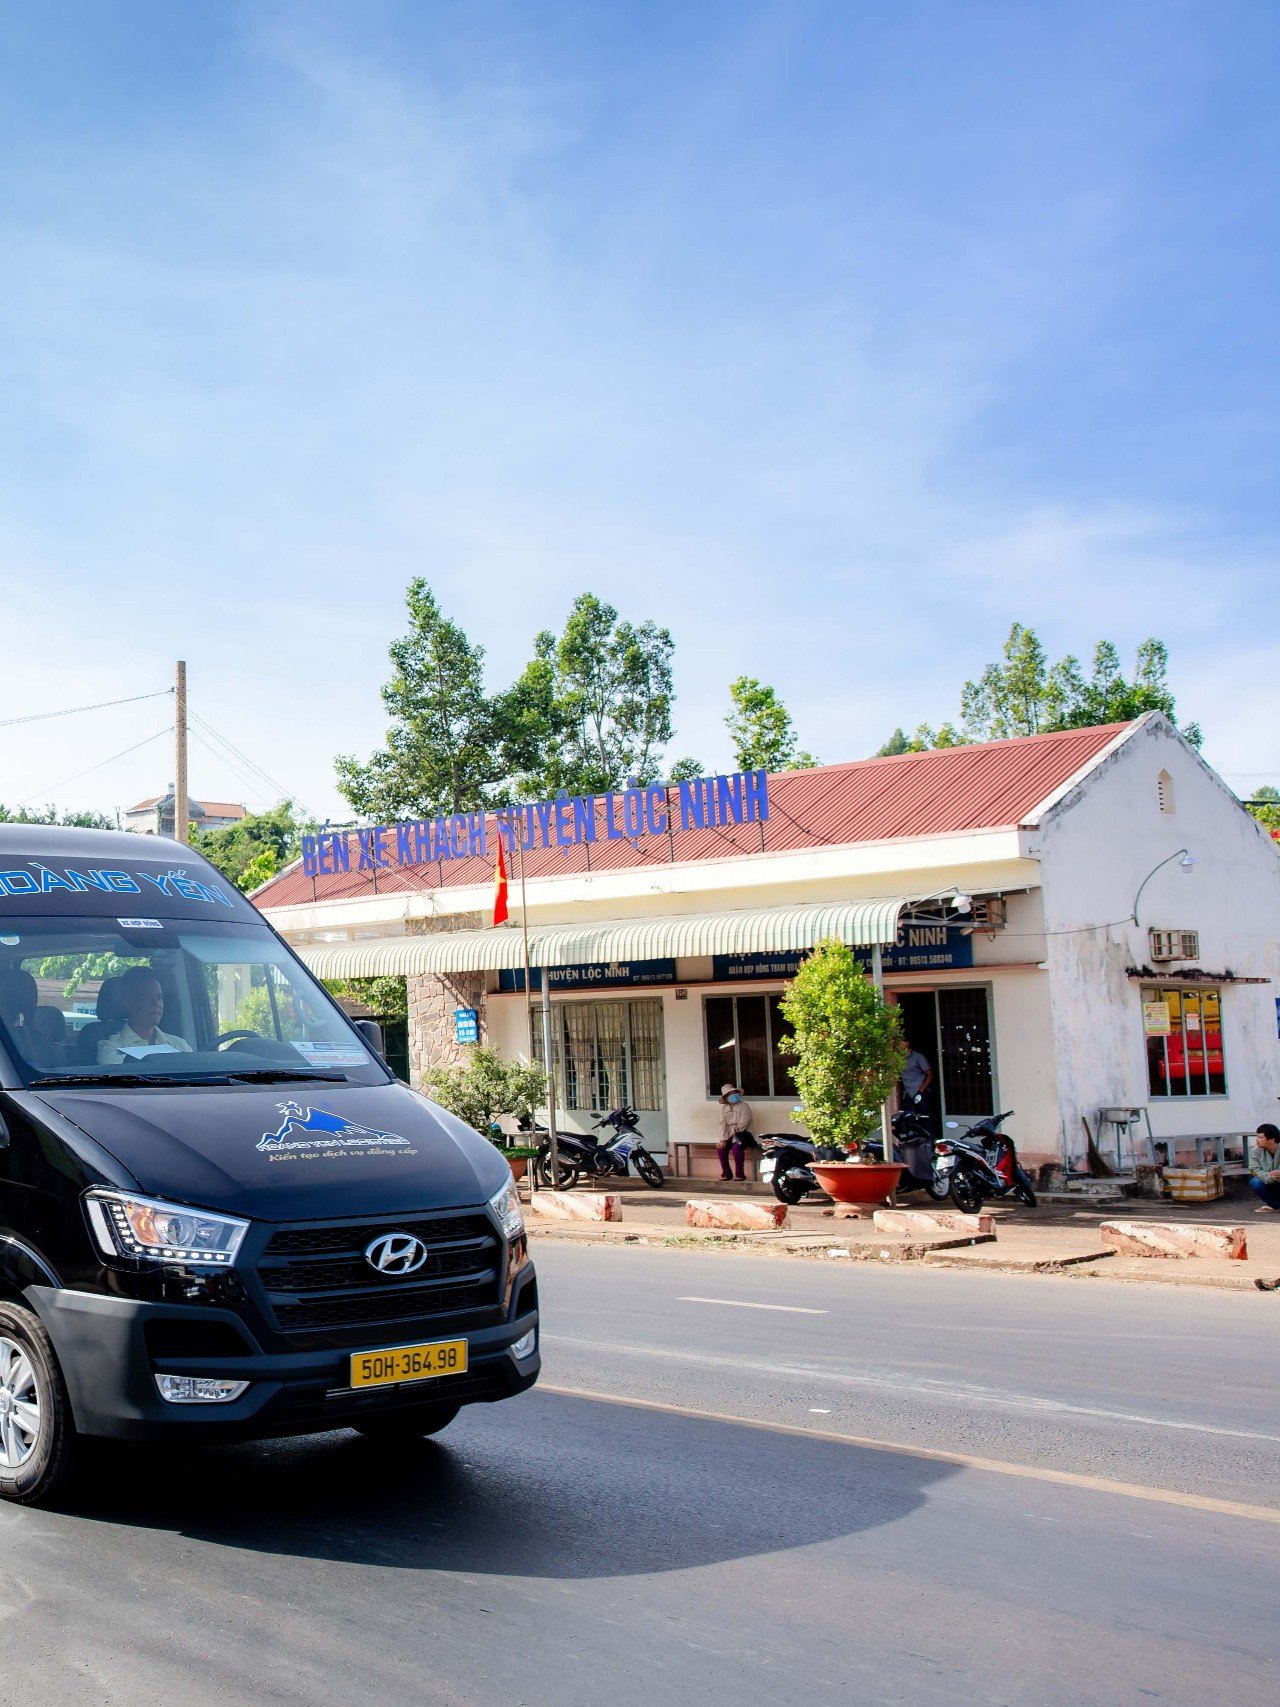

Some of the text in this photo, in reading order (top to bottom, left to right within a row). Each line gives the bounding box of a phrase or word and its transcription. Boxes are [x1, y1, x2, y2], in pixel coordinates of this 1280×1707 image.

[302, 769, 769, 877] BẾN XE KHÁCH HUYỆN LỘC NINH
[136, 870, 234, 908] YẾN
[909, 926, 947, 946] NINH
[547, 968, 579, 982] HUYỆN
[582, 966, 602, 982] LỘC
[604, 966, 630, 978] NINH
[322, 1150, 347, 1160] dịch
[362, 1348, 457, 1380] 50H-364.98
